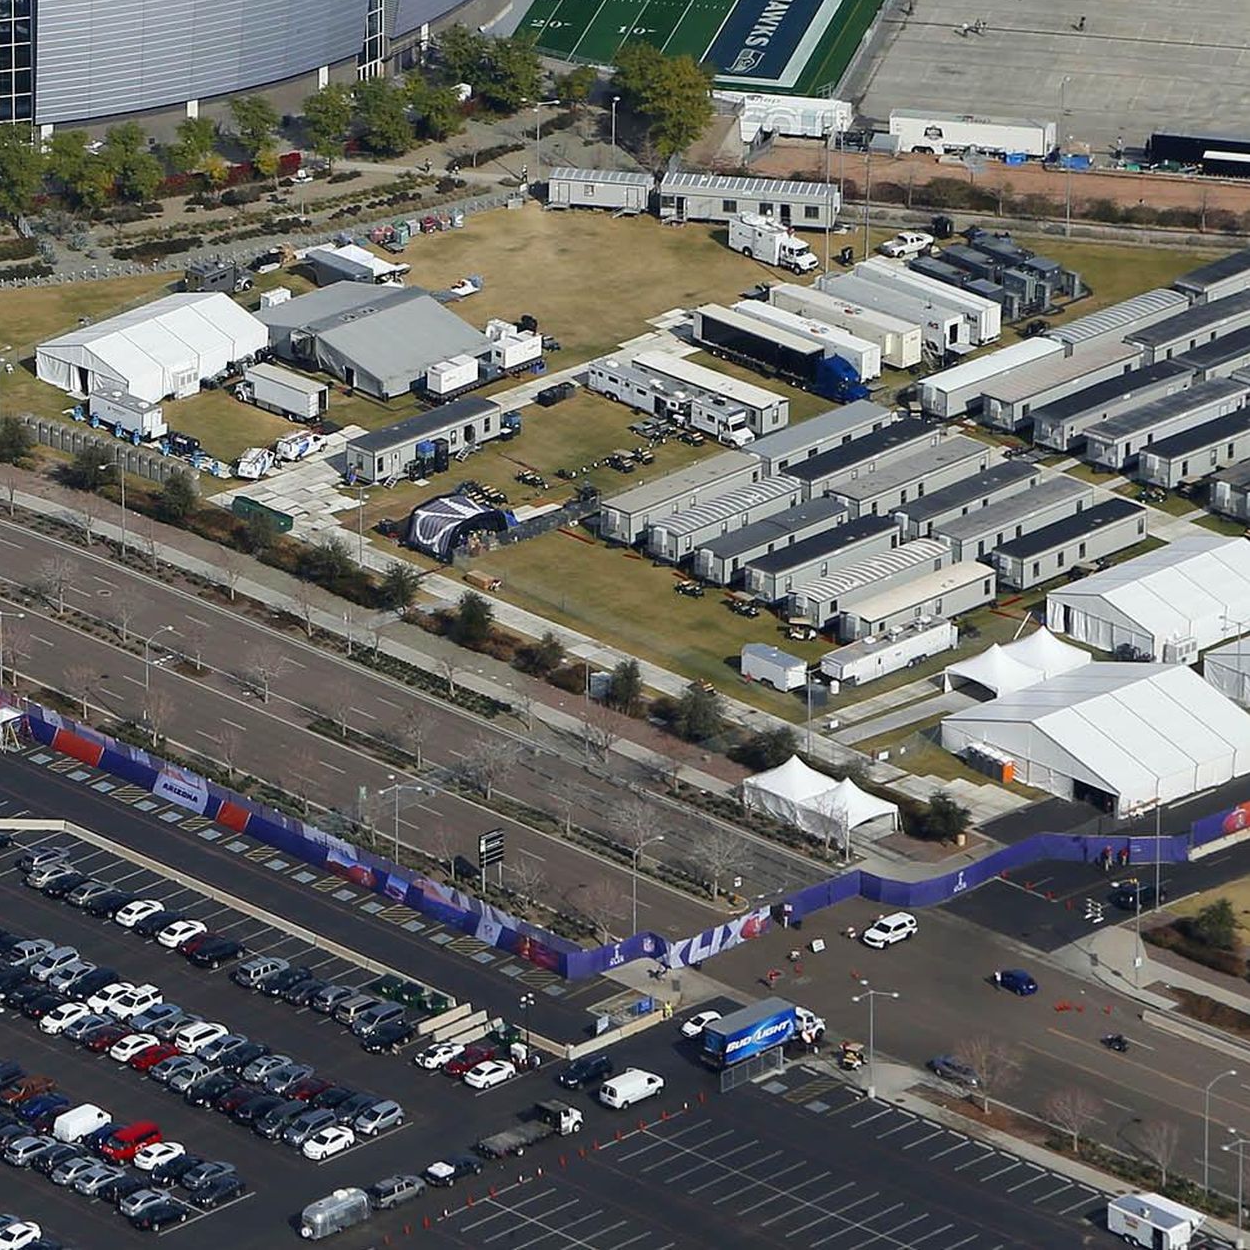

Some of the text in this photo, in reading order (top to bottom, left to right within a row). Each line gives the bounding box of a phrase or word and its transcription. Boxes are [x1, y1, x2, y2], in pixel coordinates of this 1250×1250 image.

[163, 782, 198, 804] ARIZONA
[669, 906, 770, 969] XLIX
[725, 1019, 791, 1054] BUD LIGHT
